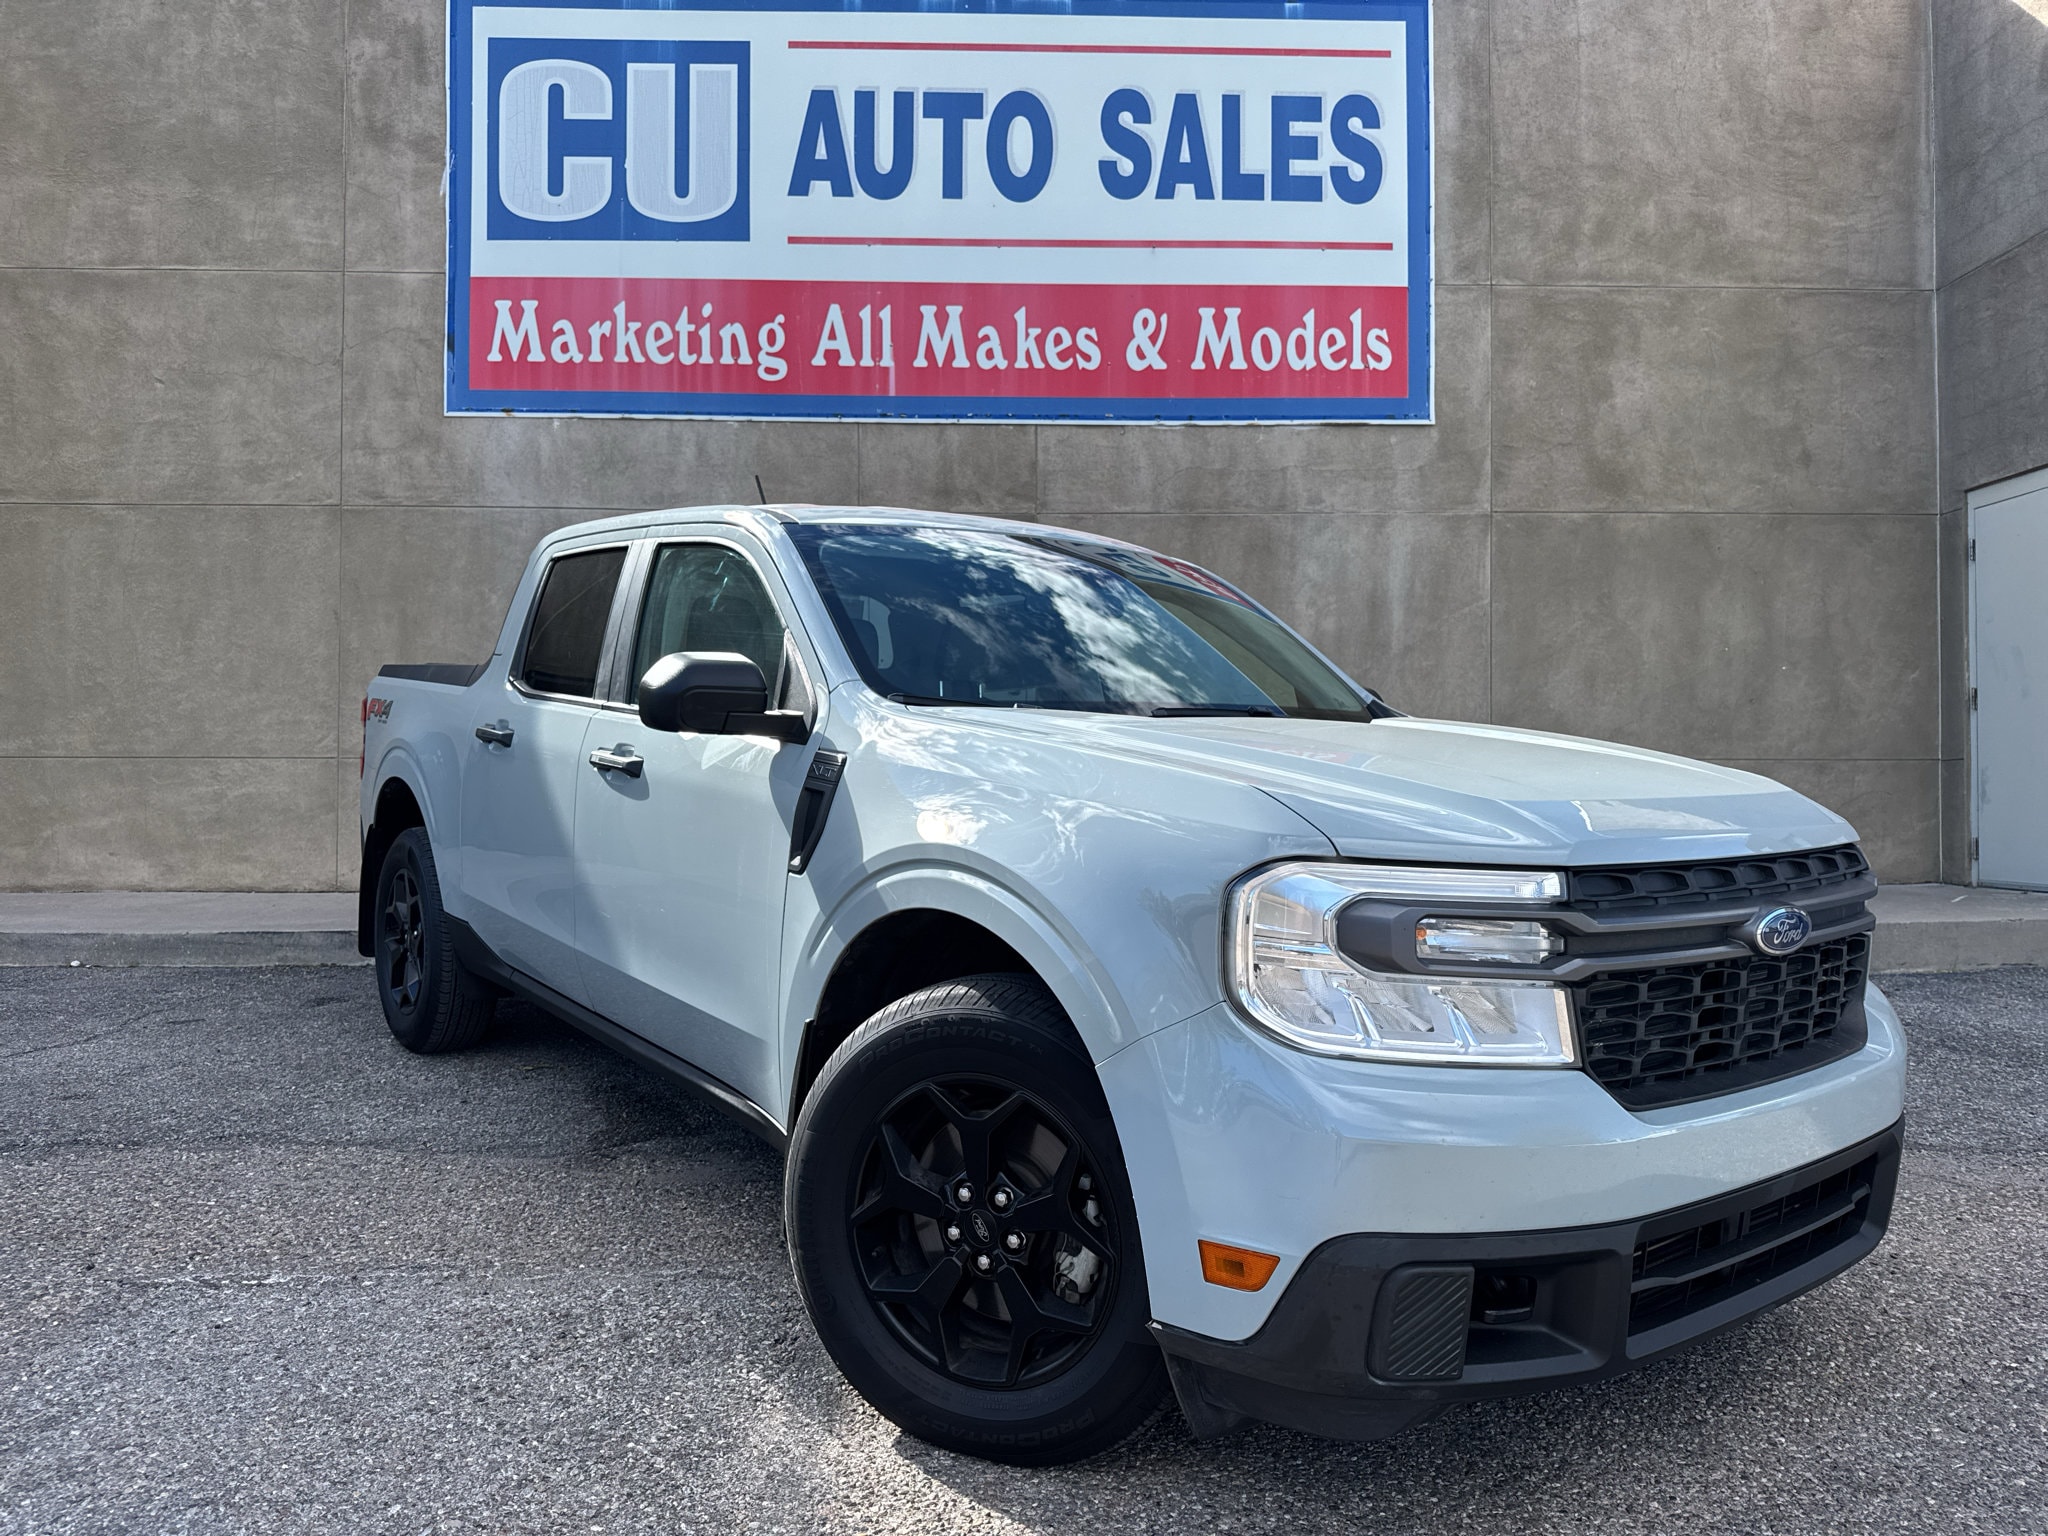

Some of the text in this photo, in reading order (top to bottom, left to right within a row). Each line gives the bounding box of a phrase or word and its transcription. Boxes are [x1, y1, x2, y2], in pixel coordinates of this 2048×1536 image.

[498, 58, 739, 223] CU
[788, 87, 1384, 205] AUTO SALES
[486, 299, 1393, 382] Marketing All Makes & Models
[367, 698, 394, 720] FX4
[1774, 918, 1804, 945] Ford
